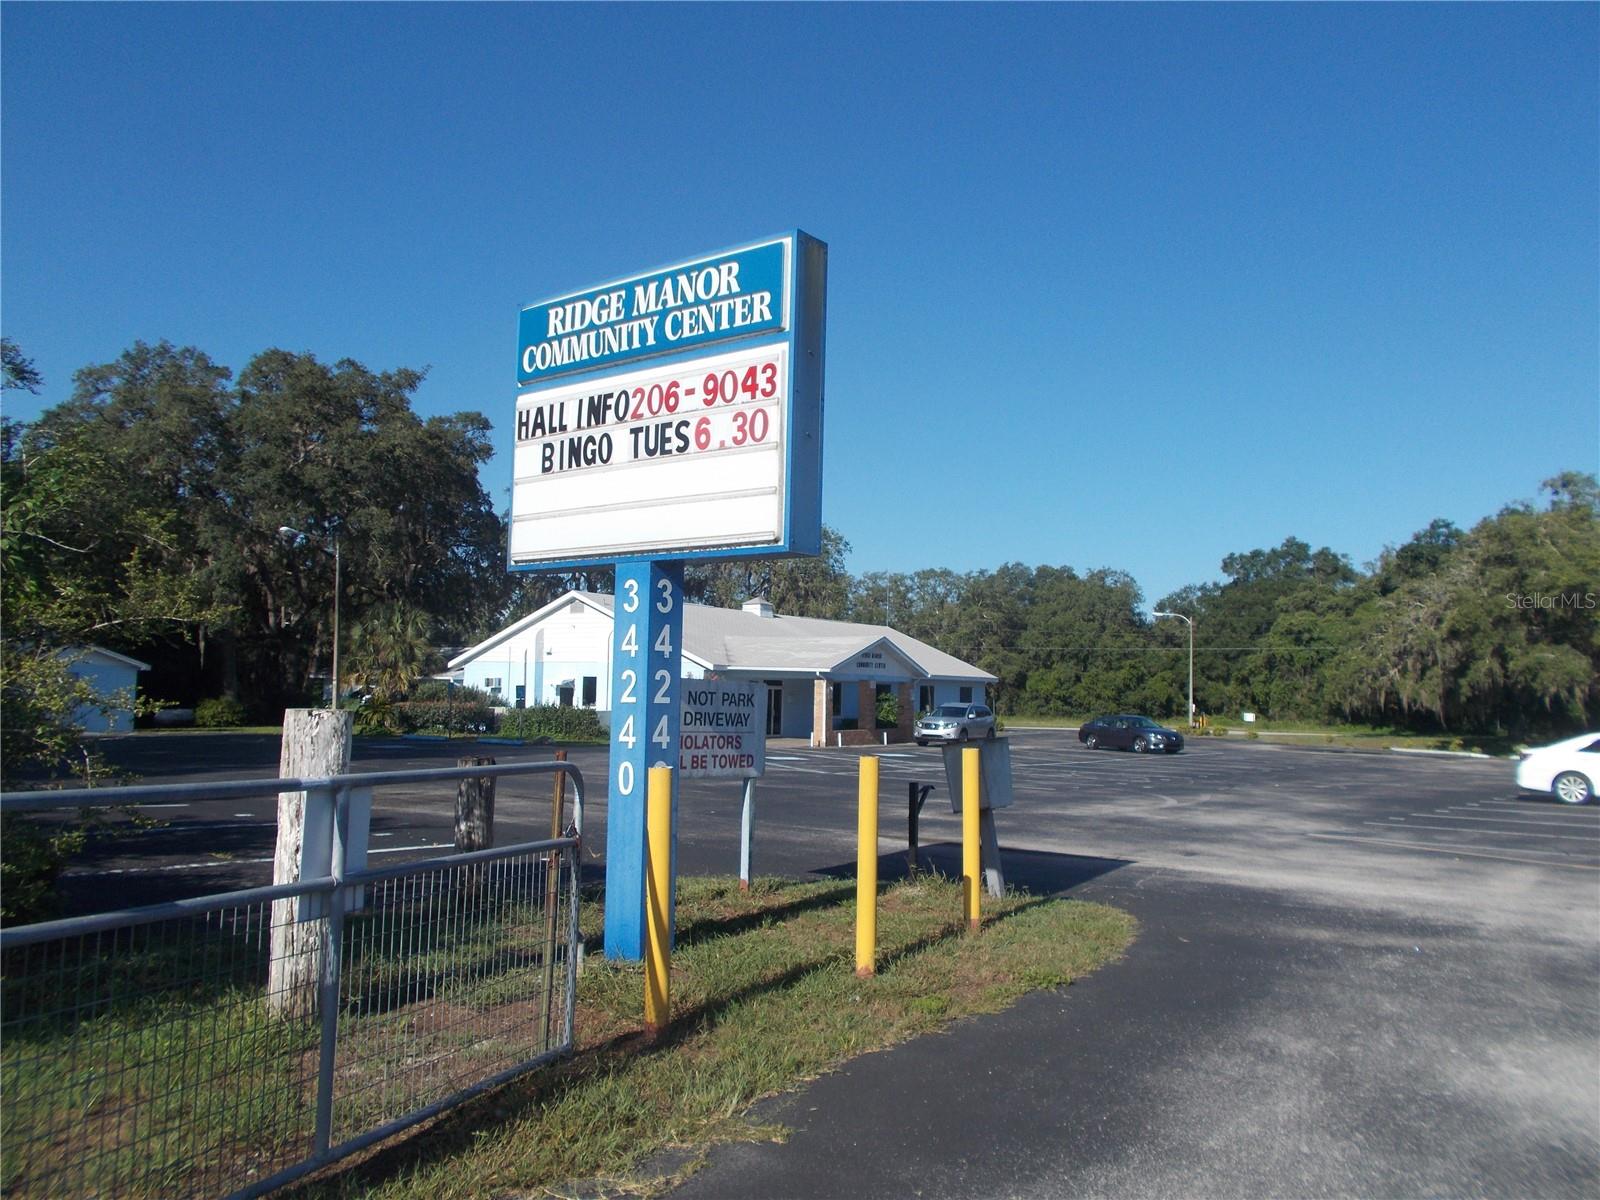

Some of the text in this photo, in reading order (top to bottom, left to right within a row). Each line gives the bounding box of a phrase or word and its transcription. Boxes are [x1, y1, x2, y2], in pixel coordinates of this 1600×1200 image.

[547, 261, 741, 337] RIDGE MANOR
[522, 291, 773, 374] COMMUNITY CENTER
[517, 363, 777, 441] HALL INFO 206-9043
[541, 408, 769, 474] BINGO TUES 6.30
[652, 579, 673, 768] 3424
[688, 690, 755, 708] NOT PARK
[680, 735, 742, 750] IOLATORS
[683, 711, 751, 727] DRIVEWAY
[691, 755, 708, 769] BE
[711, 754, 755, 769] TOWED
